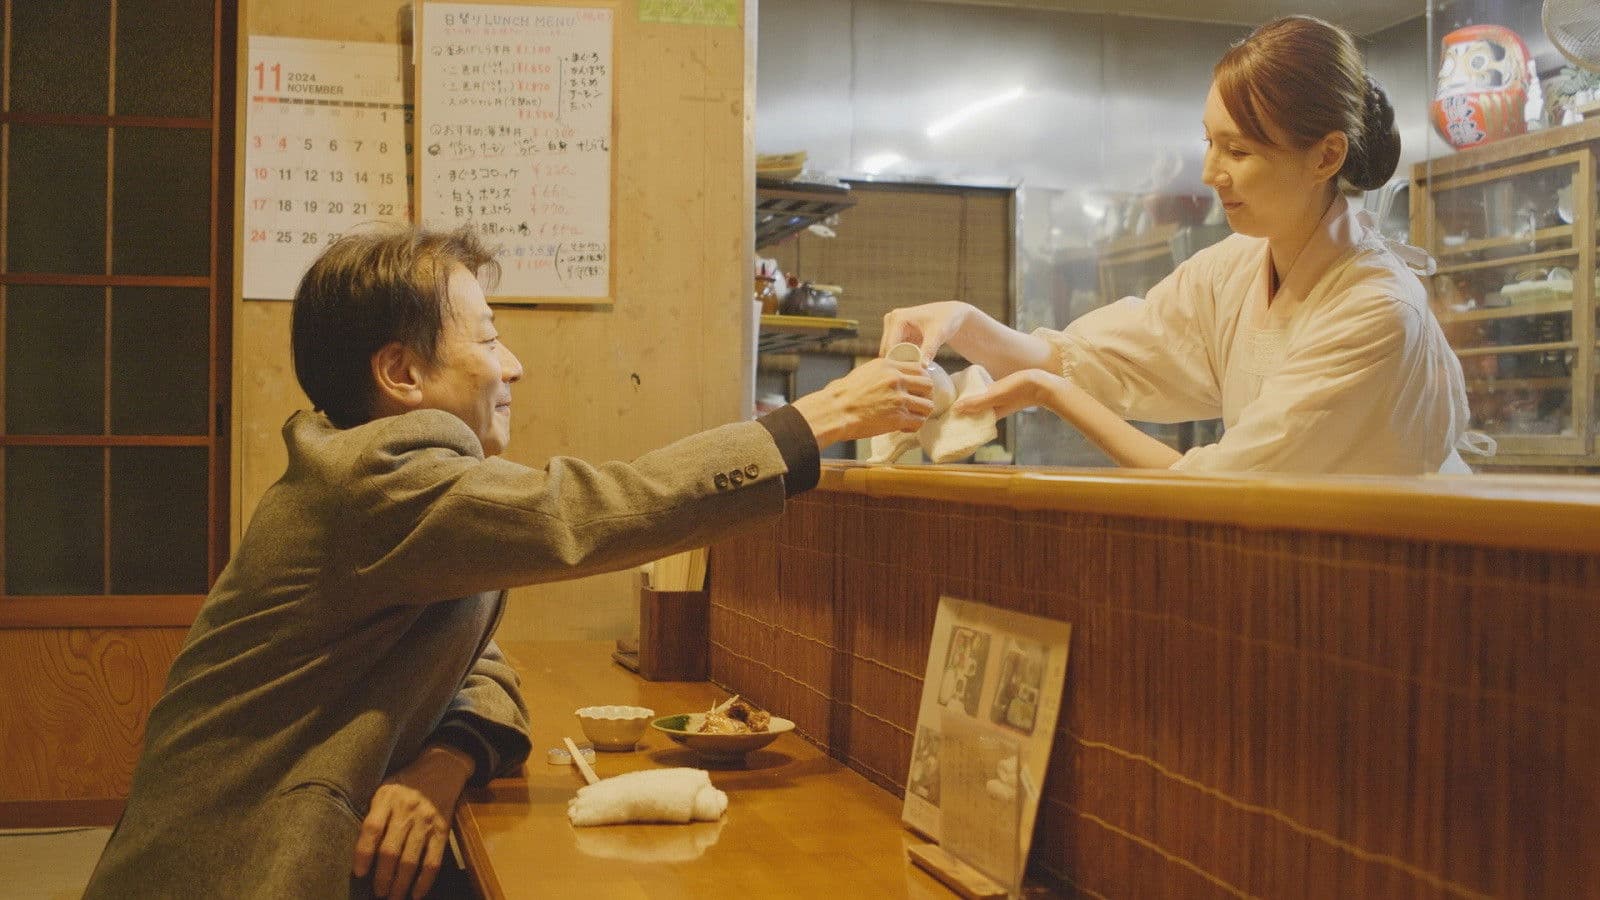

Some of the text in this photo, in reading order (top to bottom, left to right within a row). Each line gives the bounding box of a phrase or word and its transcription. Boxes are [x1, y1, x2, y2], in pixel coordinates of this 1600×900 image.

[484, 15, 530, 27] LUNCH
[535, 15, 577, 28] MENU
[254, 61, 282, 92] 11
[287, 72, 317, 83] 2024
[287, 84, 345, 95] NOVEMBER
[380, 111, 387, 123] 1
[254, 135, 262, 148] 3
[279, 137, 287, 149] 4
[304, 138, 313, 151] 5
[329, 139, 338, 152] 6
[354, 140, 363, 153] 7
[379, 141, 388, 154] 8
[254, 167, 268, 181] 10
[279, 169, 291, 181] 11
[304, 169, 318, 182] 12
[329, 171, 344, 183] 13
[354, 171, 368, 184] 14
[380, 173, 394, 185] 15
[253, 199, 267, 211] 17
[278, 200, 292, 212] 18
[303, 201, 318, 213] 19
[328, 202, 344, 214] 20
[353, 203, 367, 215] 21
[378, 204, 394, 216] 22
[251, 229, 267, 242] 24
[276, 231, 293, 244] 25
[302, 232, 318, 245] 26
